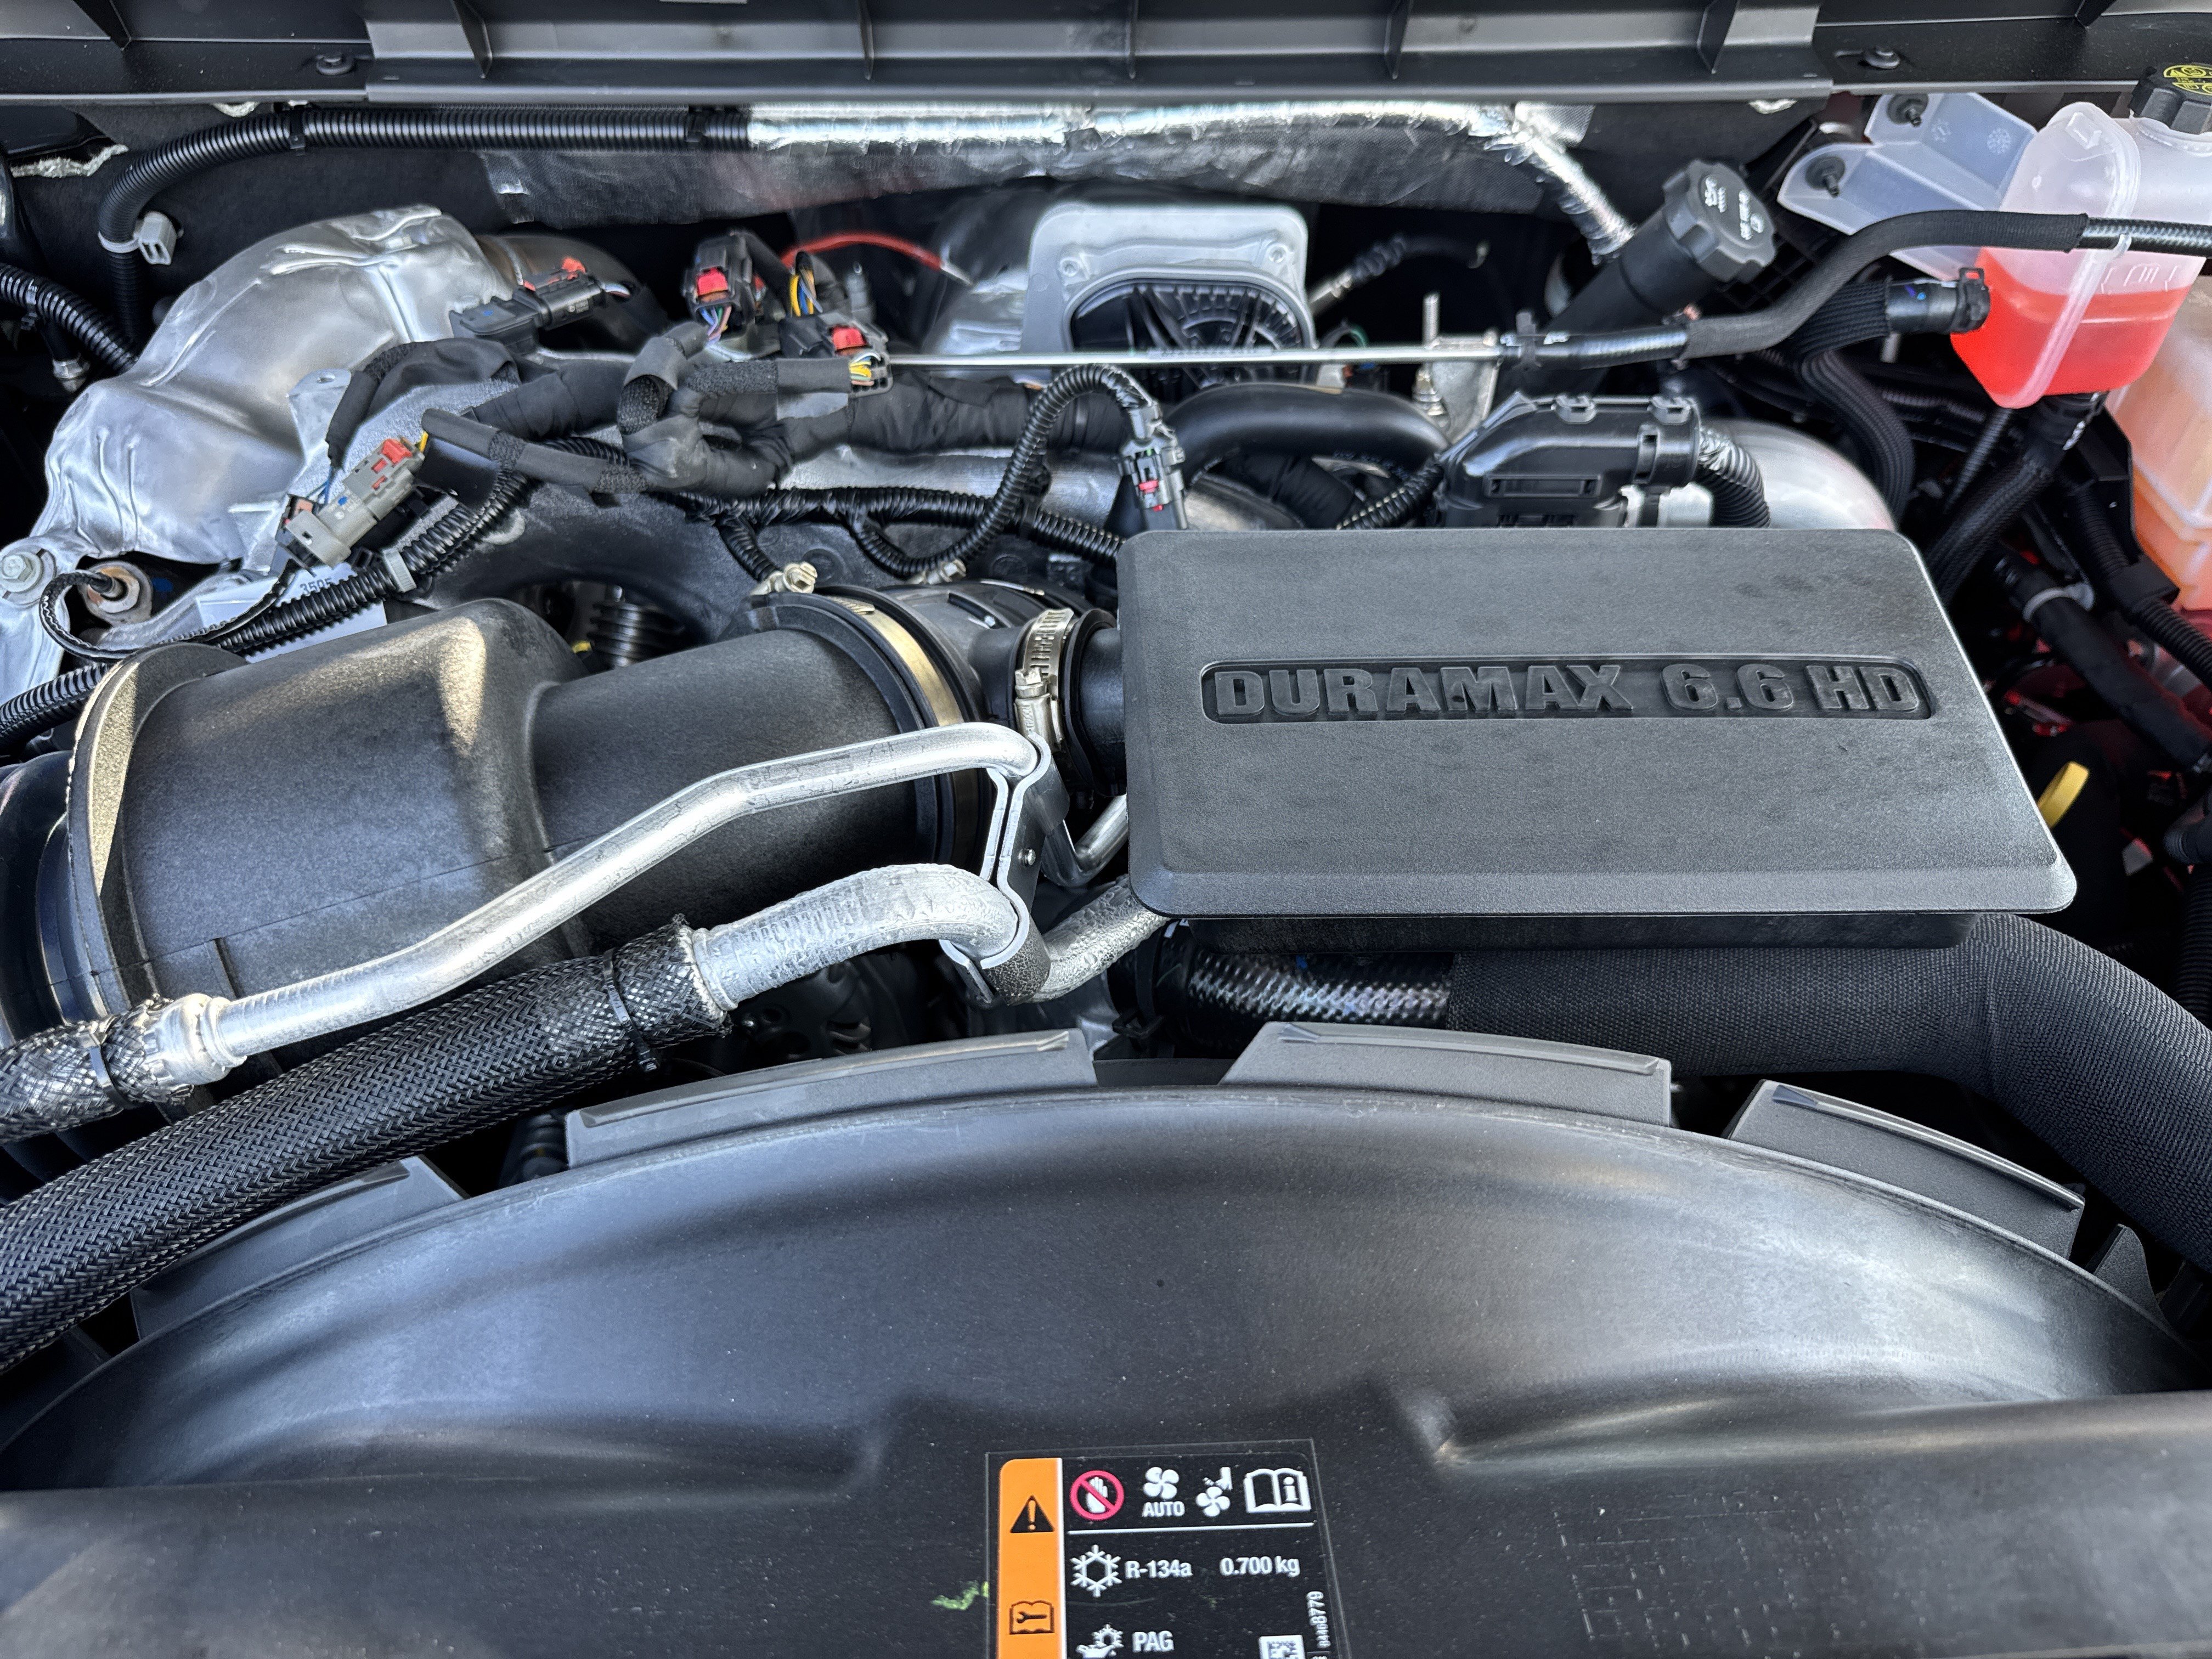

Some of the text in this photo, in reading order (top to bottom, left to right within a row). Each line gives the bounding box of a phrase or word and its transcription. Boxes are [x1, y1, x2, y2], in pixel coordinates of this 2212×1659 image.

[1214, 663, 1920, 716] DURAMAX 6.6 HD
[1142, 1501, 1185, 1517] AUTO
[1125, 1555, 1300, 1579] R-134a 0.700 kg
[1132, 1630, 1174, 1652] PAG
